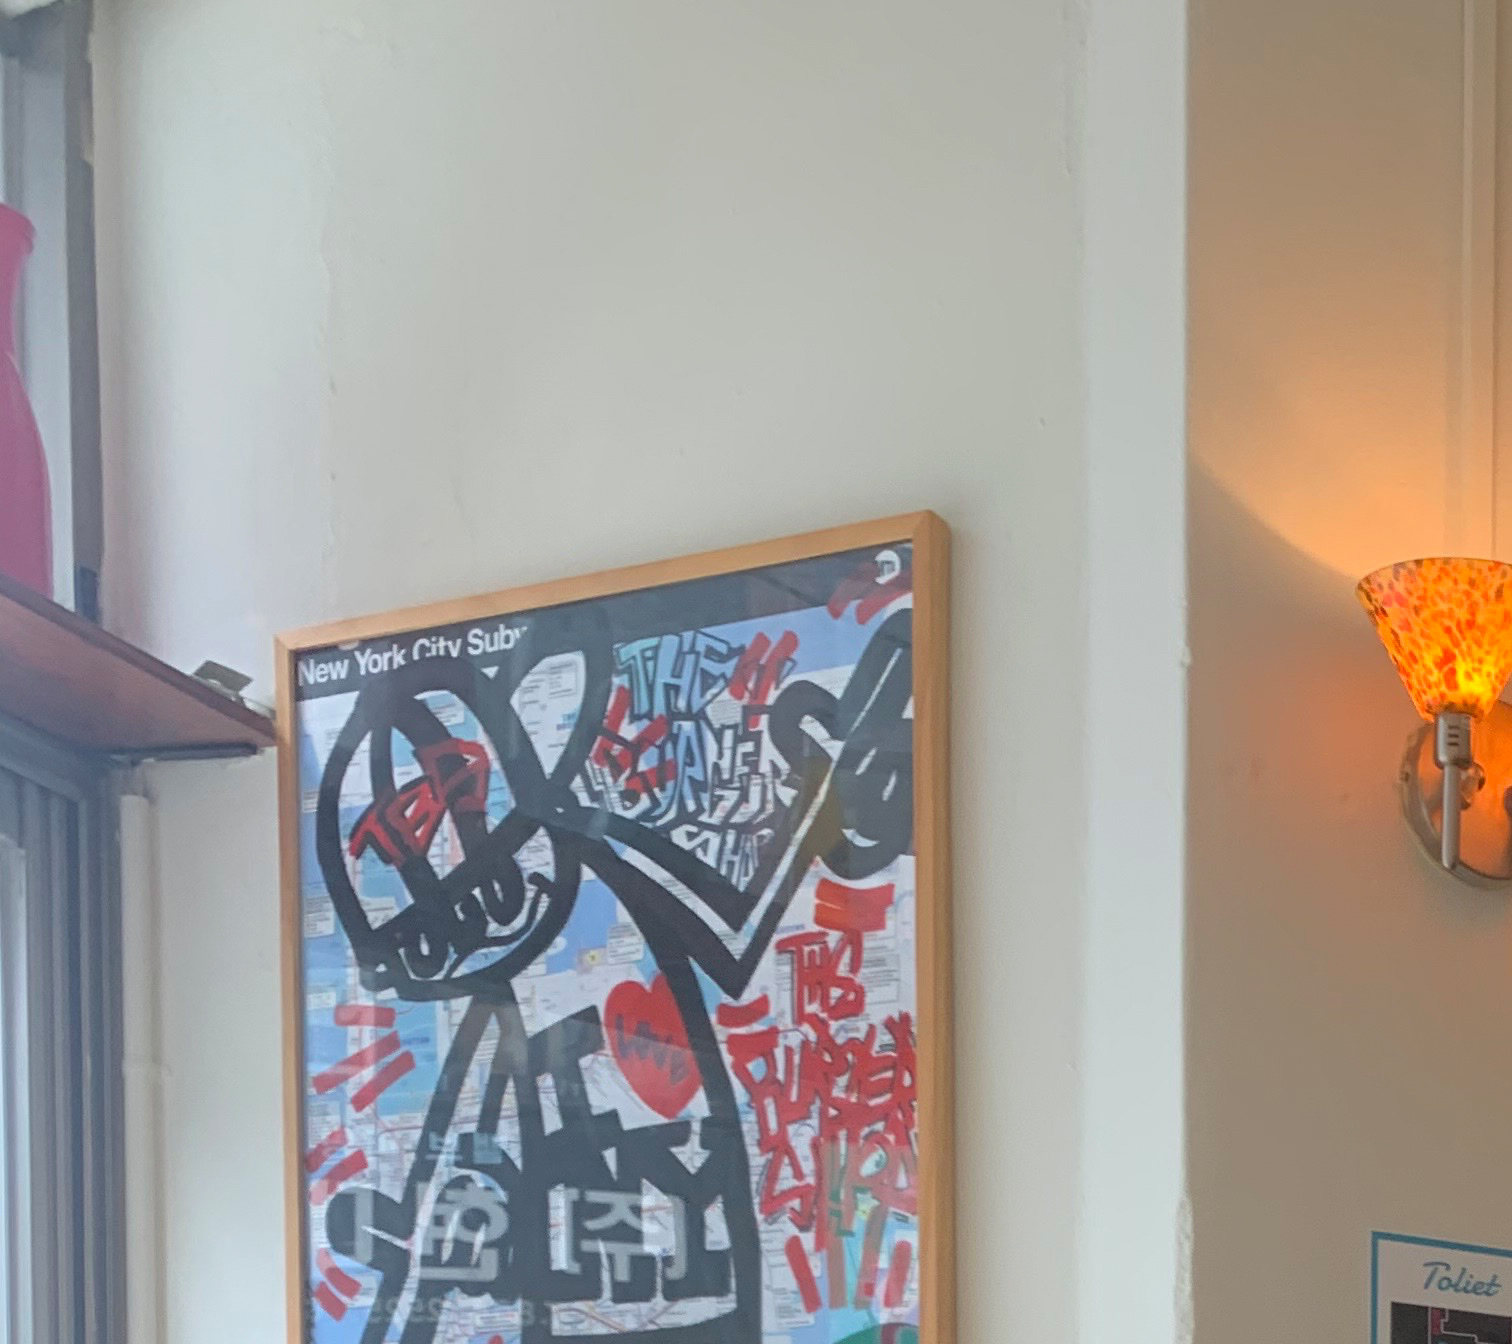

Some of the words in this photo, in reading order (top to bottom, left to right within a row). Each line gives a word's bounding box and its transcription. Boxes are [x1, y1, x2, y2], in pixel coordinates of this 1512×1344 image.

[298, 658, 349, 687] New
[354, 643, 407, 676] York
[1422, 1260, 1502, 1299] Toliet
